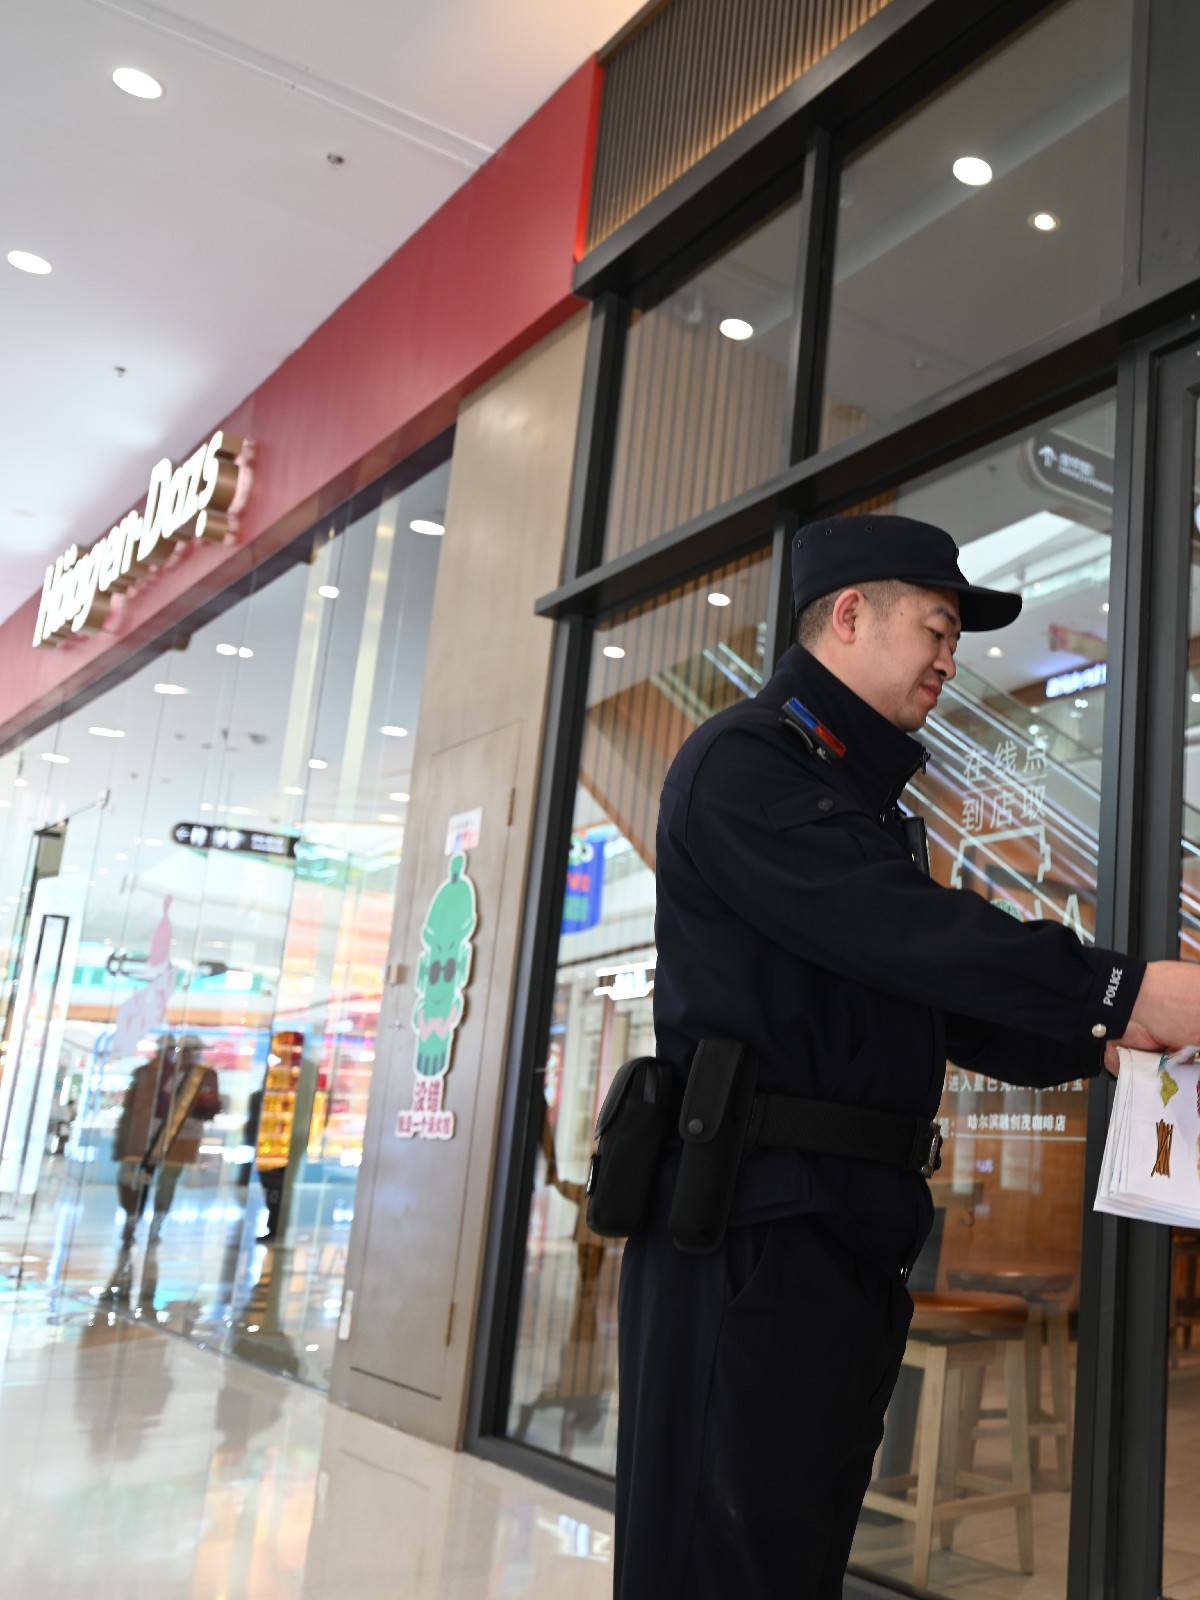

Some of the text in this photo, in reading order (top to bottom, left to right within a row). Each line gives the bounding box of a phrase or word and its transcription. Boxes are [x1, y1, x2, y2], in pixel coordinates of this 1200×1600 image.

[963, 733, 1049, 783] 在线点
[961, 785, 1047, 832] 到店取
[1103, 966, 1123, 1007] POLICE
